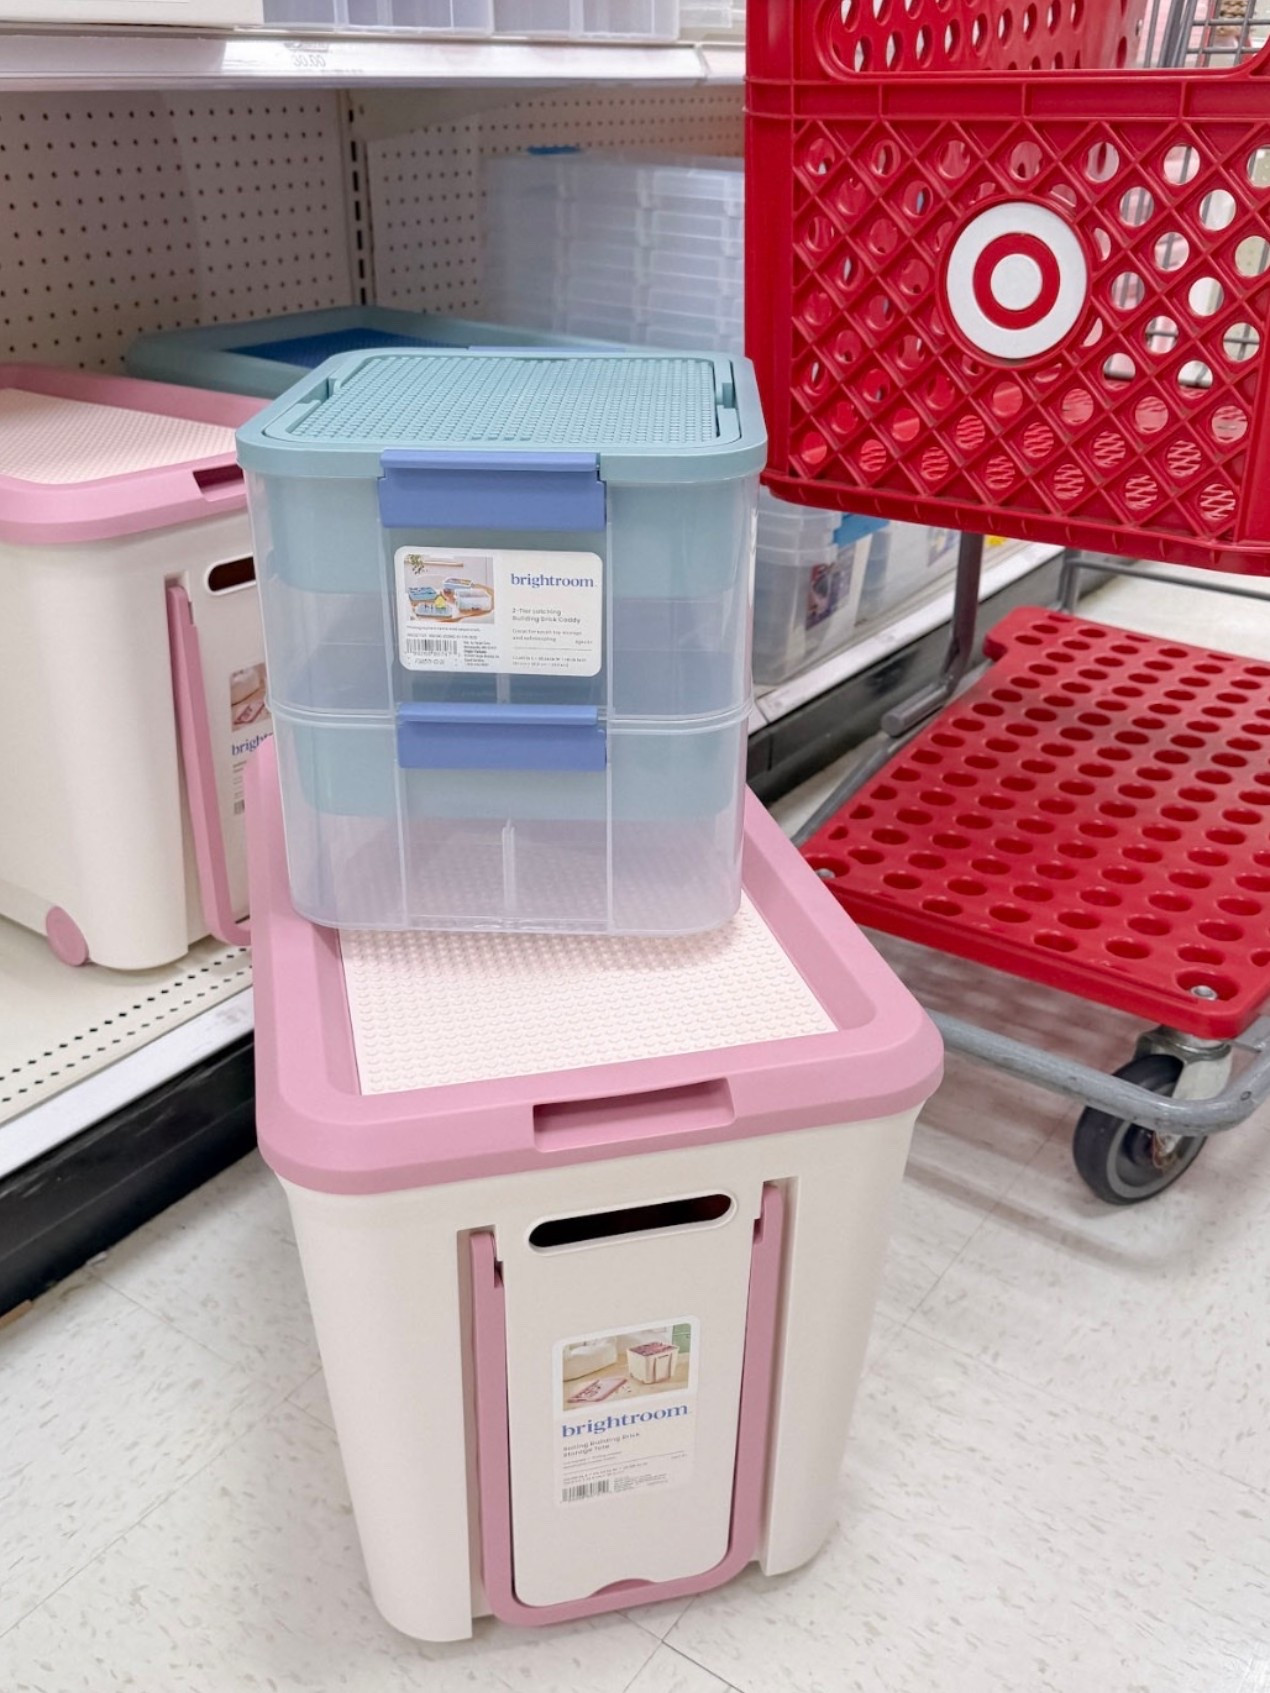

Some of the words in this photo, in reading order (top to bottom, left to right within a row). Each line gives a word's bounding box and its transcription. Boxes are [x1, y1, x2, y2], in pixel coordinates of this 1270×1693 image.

[510, 573, 594, 588] brightroom
[512, 615, 540, 623] Building
[558, 616, 581, 624] Caddy
[562, 1405, 688, 1437] brightroom
